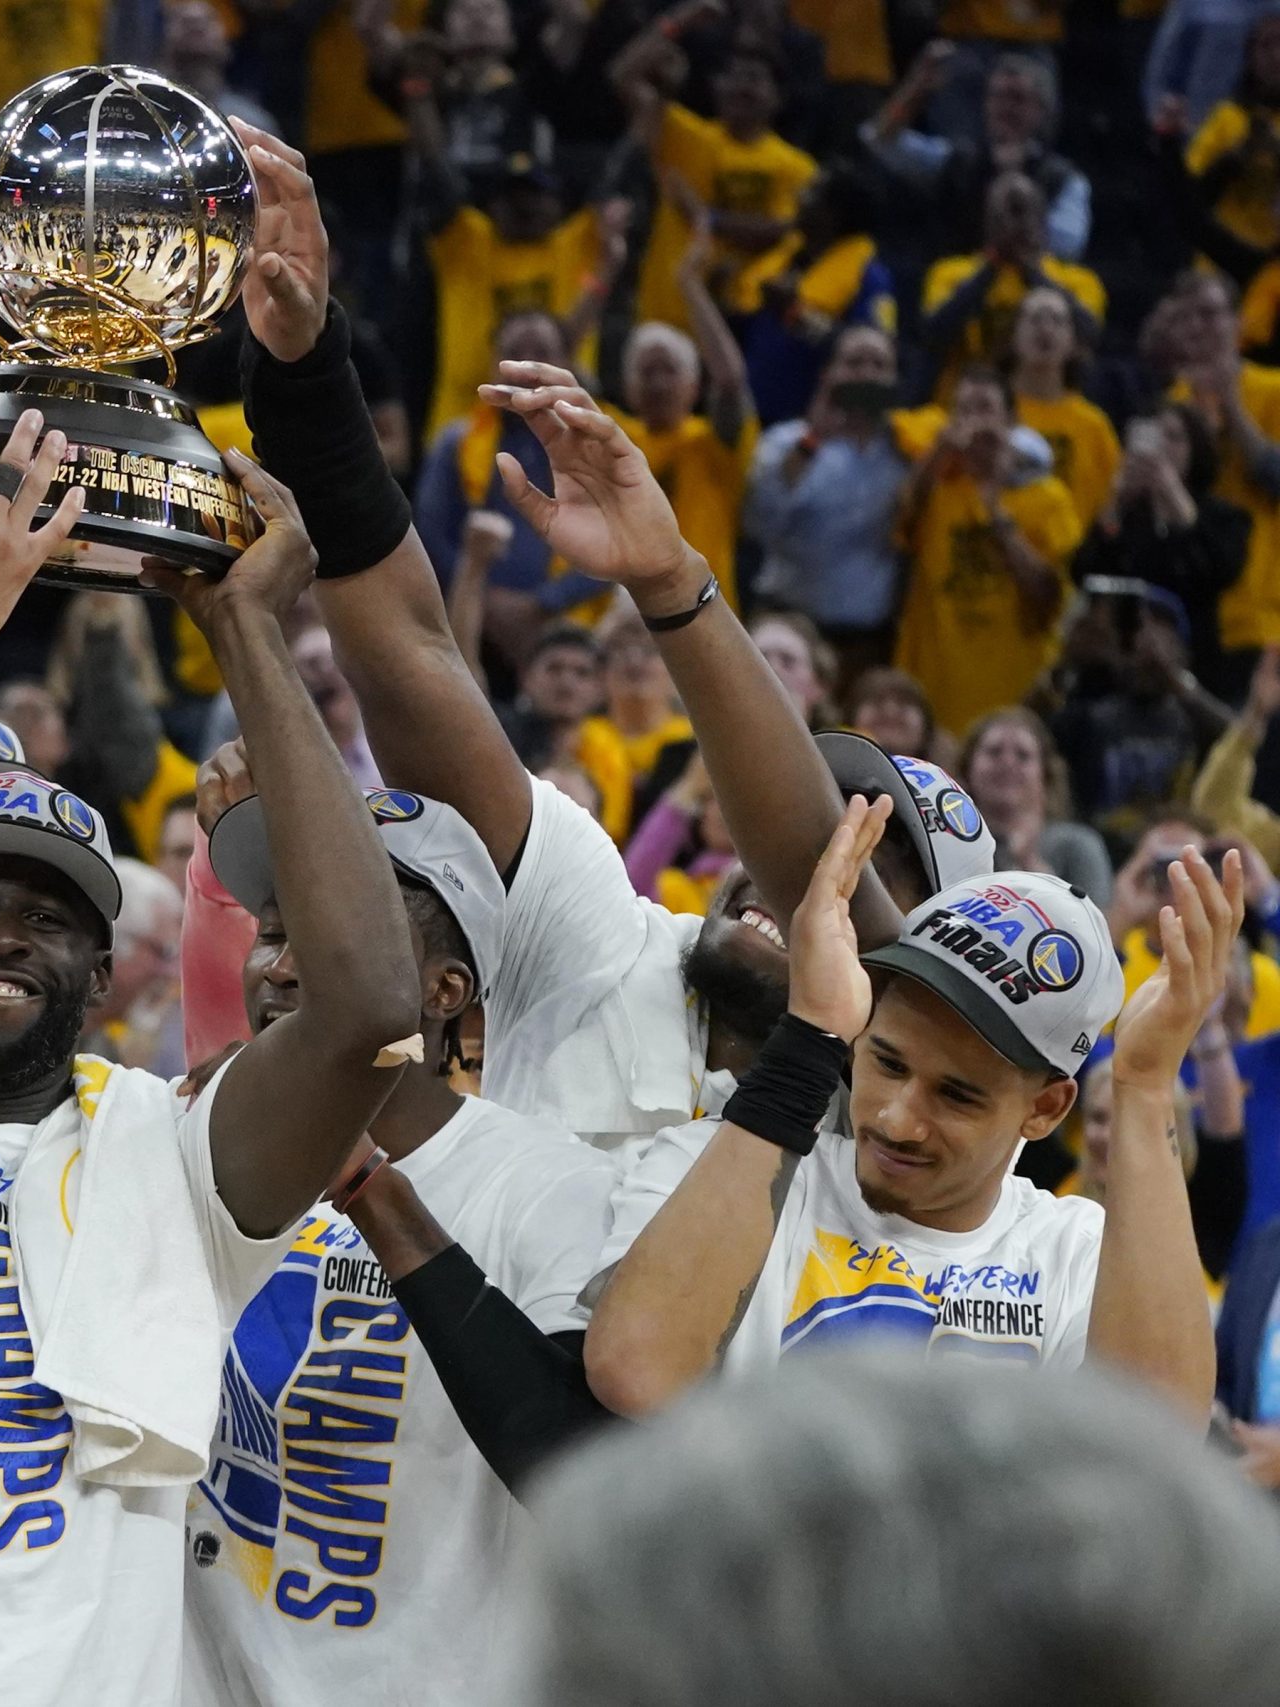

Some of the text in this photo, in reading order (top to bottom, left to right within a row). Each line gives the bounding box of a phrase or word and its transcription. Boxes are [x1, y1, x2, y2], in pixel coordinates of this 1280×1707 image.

[90, 447, 117, 471] THE
[121, 455, 166, 481] OSCAR
[101, 471, 129, 494] NBA
[132, 476, 190, 508] WESTERN
[945, 897, 1026, 948] NBA
[910, 908, 1042, 1005] Finals
[922, 1263, 1040, 1299] WESTERN
[934, 1297, 1044, 1338] CONFERENCE
[273, 1298, 411, 1631] CHAMPS
